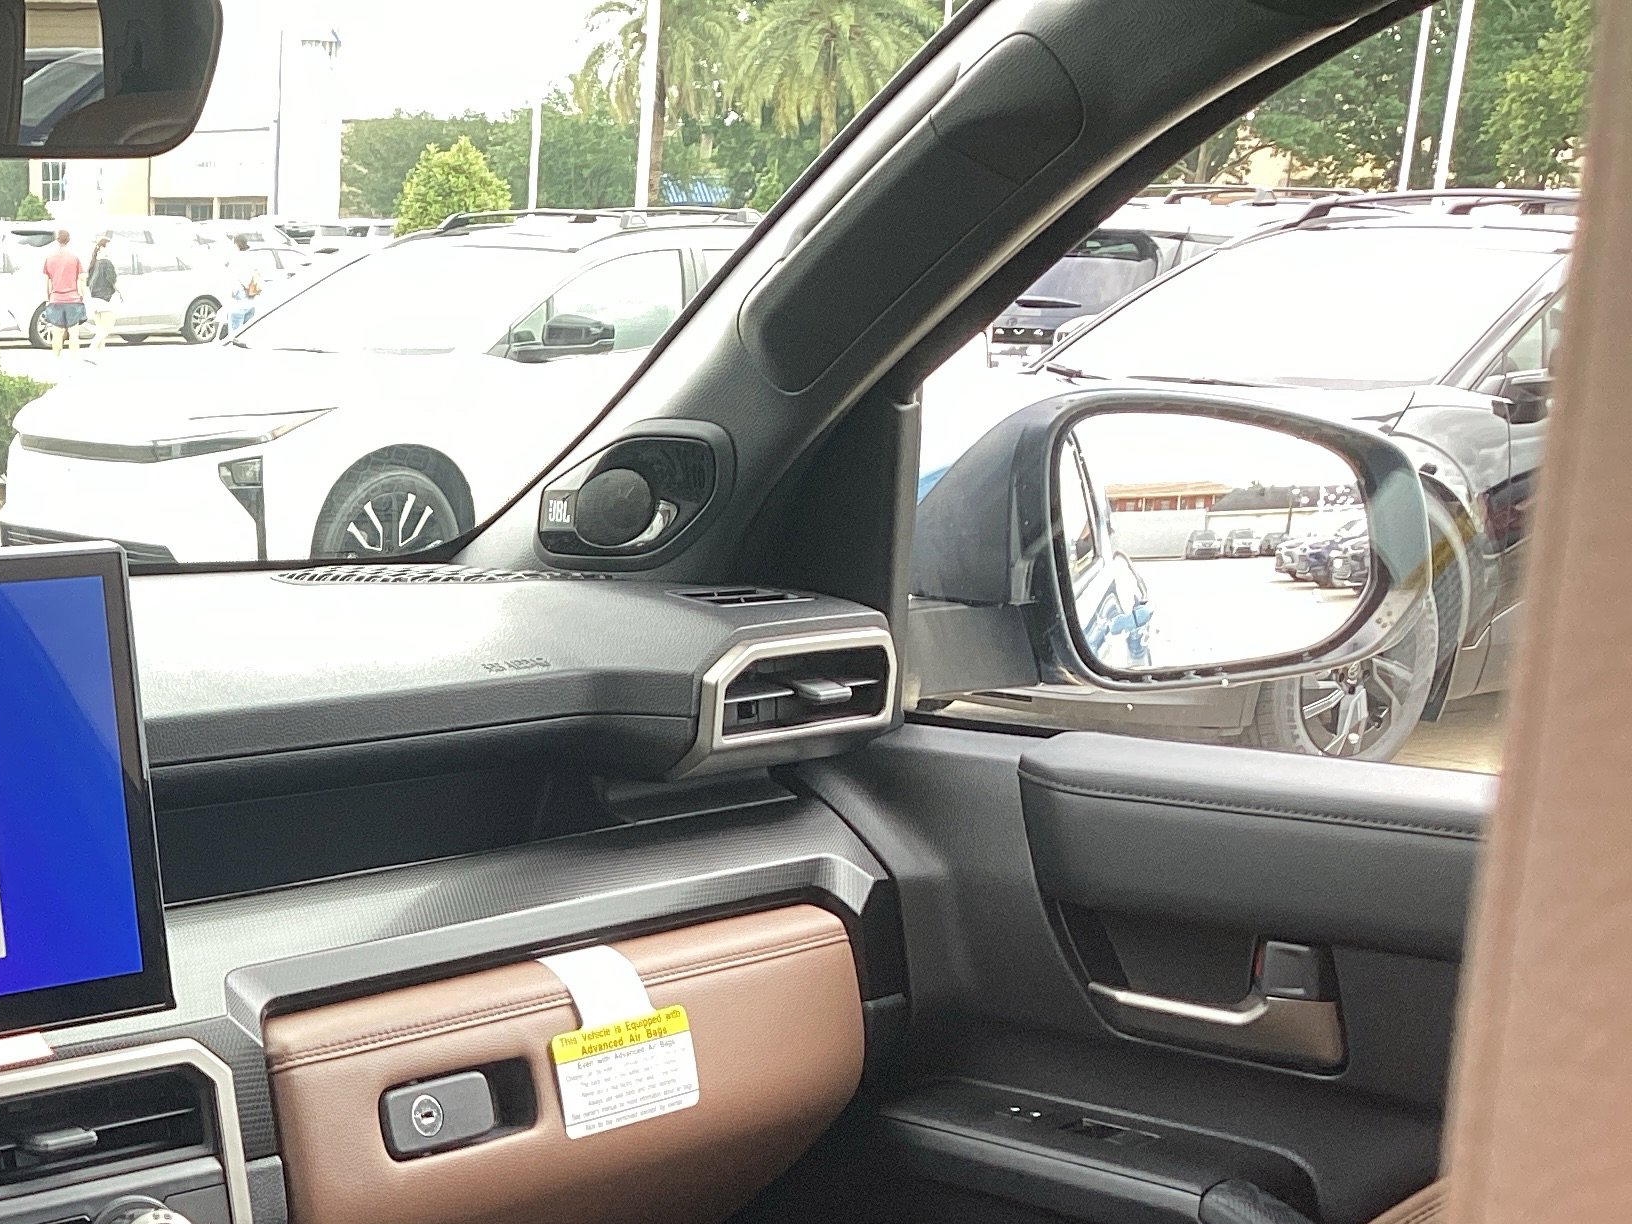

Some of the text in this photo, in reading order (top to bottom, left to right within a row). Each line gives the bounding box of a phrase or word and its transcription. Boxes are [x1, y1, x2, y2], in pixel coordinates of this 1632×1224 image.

[549, 500, 571, 523] JBL
[625, 1014, 662, 1031] Equipped
[581, 1037, 624, 1056] Advanced
[646, 1026, 668, 1039] Bags
